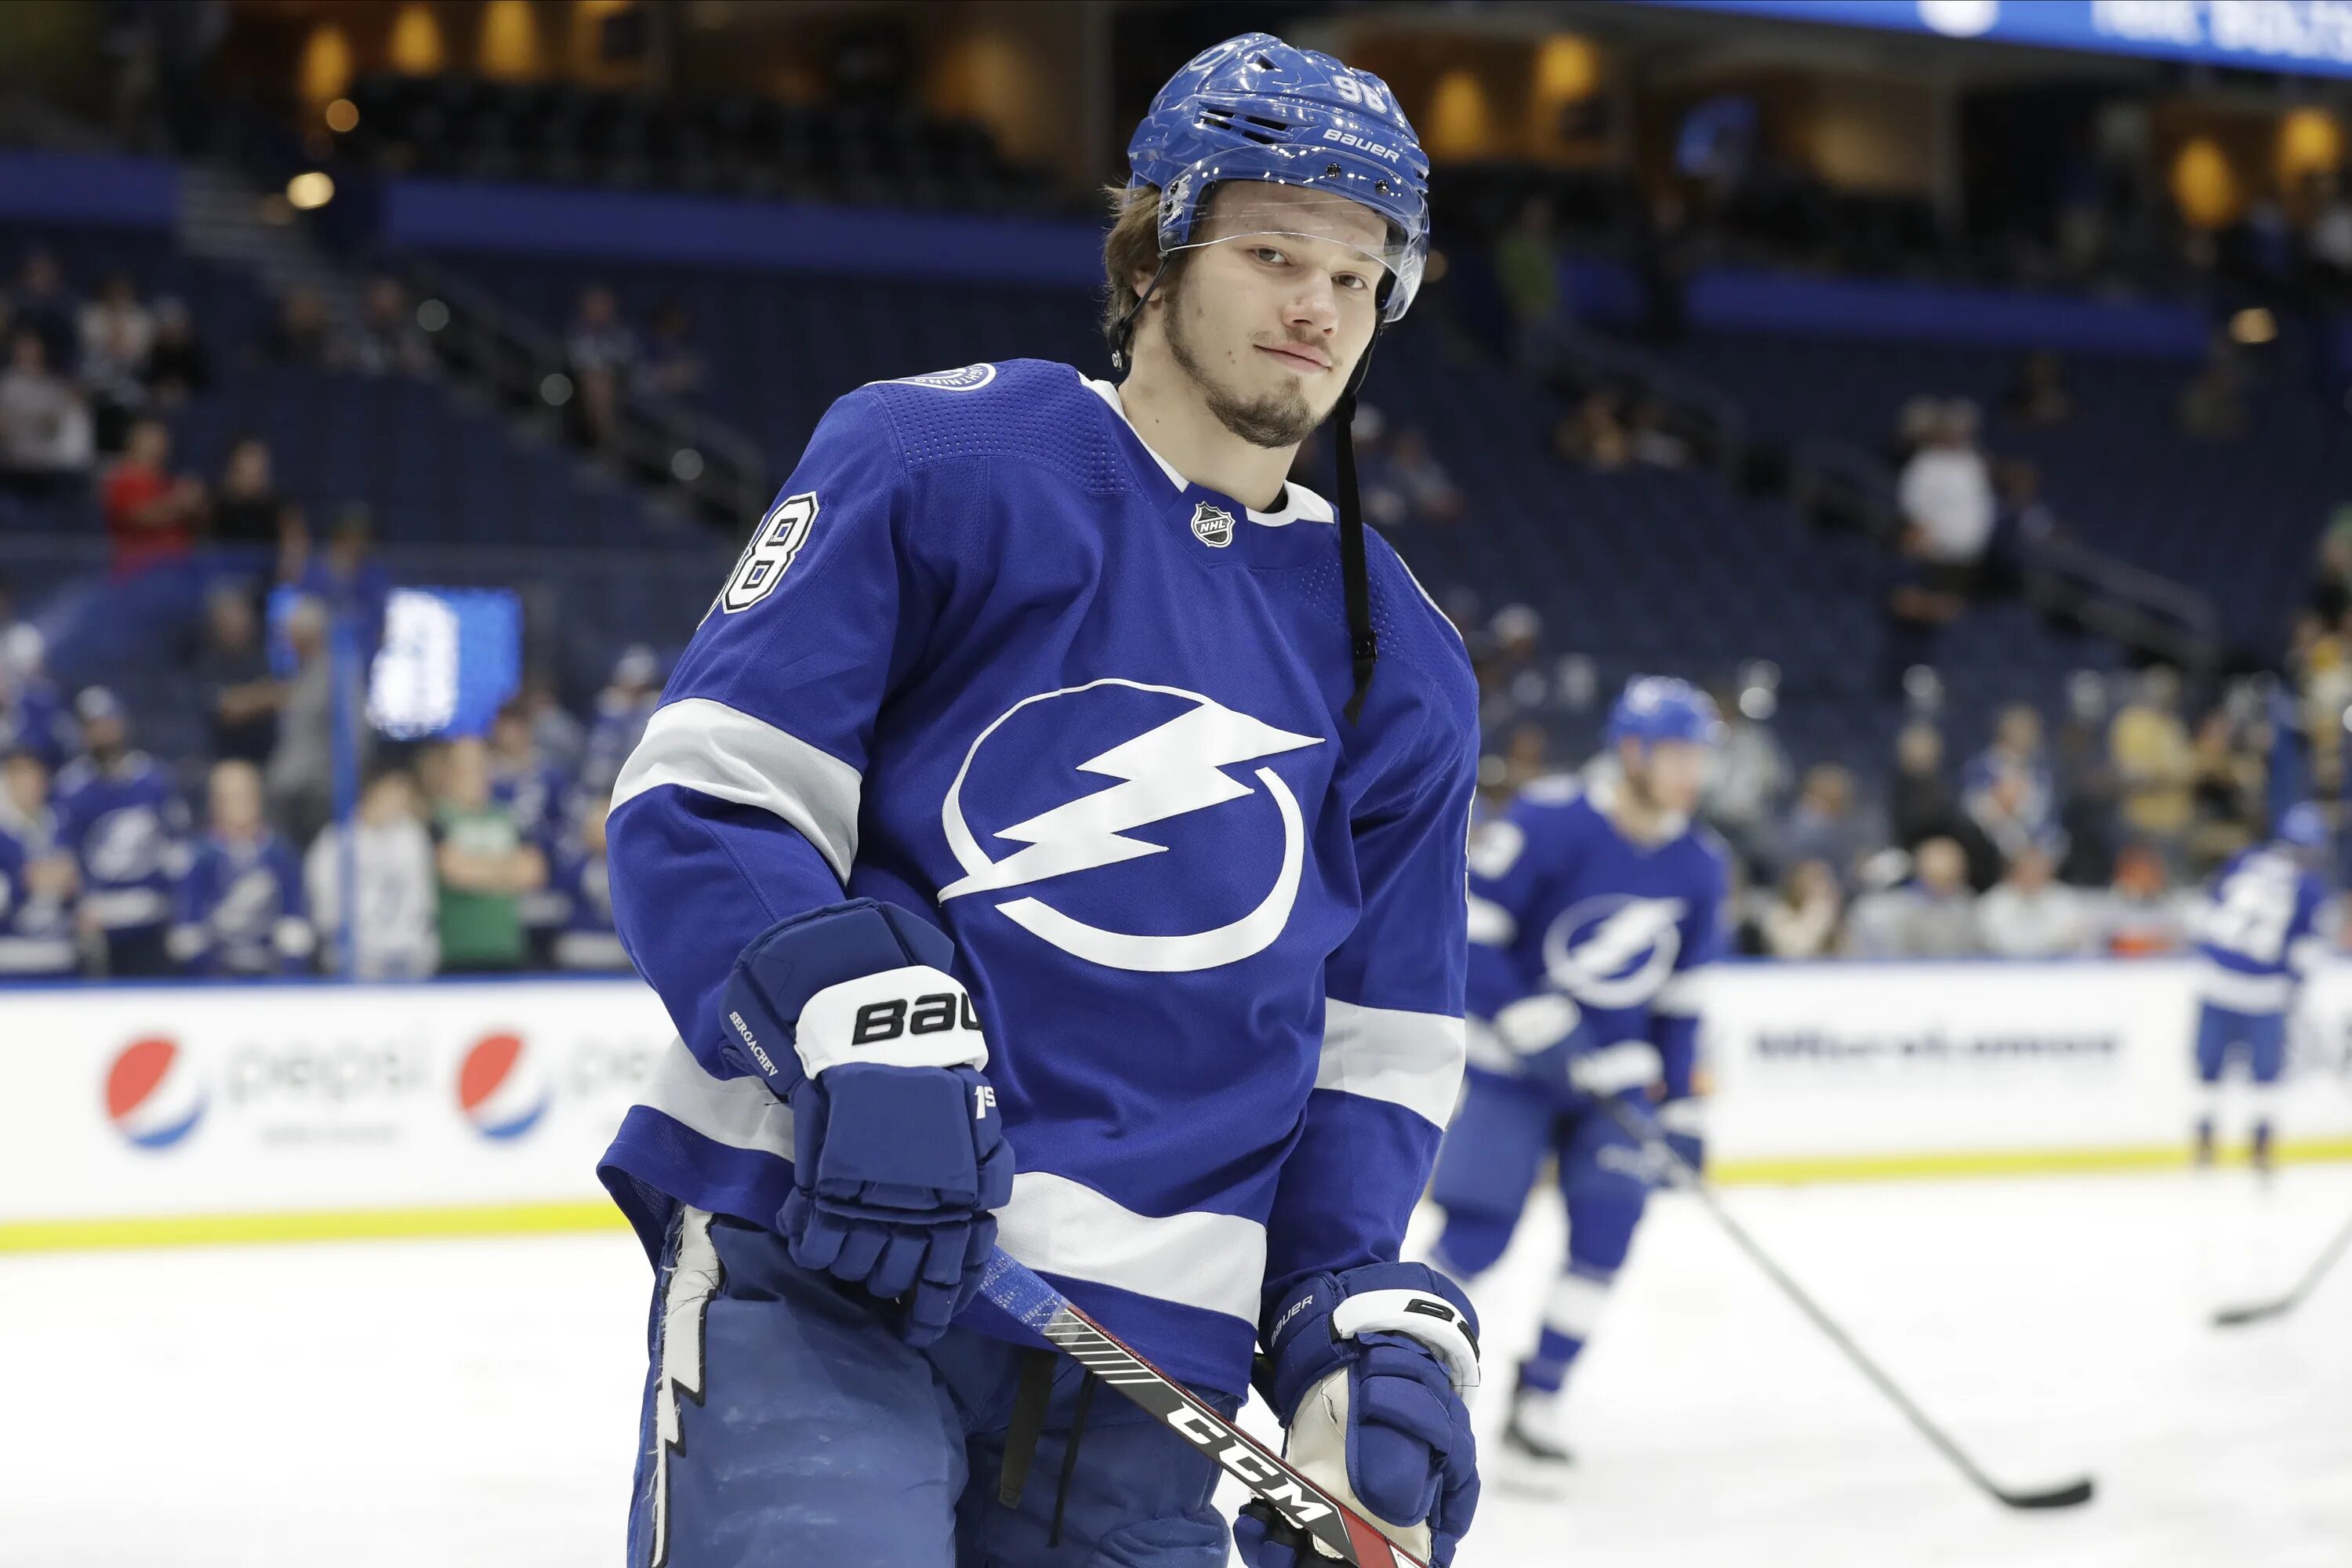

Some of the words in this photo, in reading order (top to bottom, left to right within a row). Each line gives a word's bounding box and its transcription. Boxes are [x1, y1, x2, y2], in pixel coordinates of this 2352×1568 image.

[1322, 128, 1400, 164] BAUER
[1200, 520, 1226, 533] NHL
[697, 491, 820, 630] 8
[728, 1011, 779, 1077] SERGACHEV
[1167, 1400, 1333, 1523] CCM
